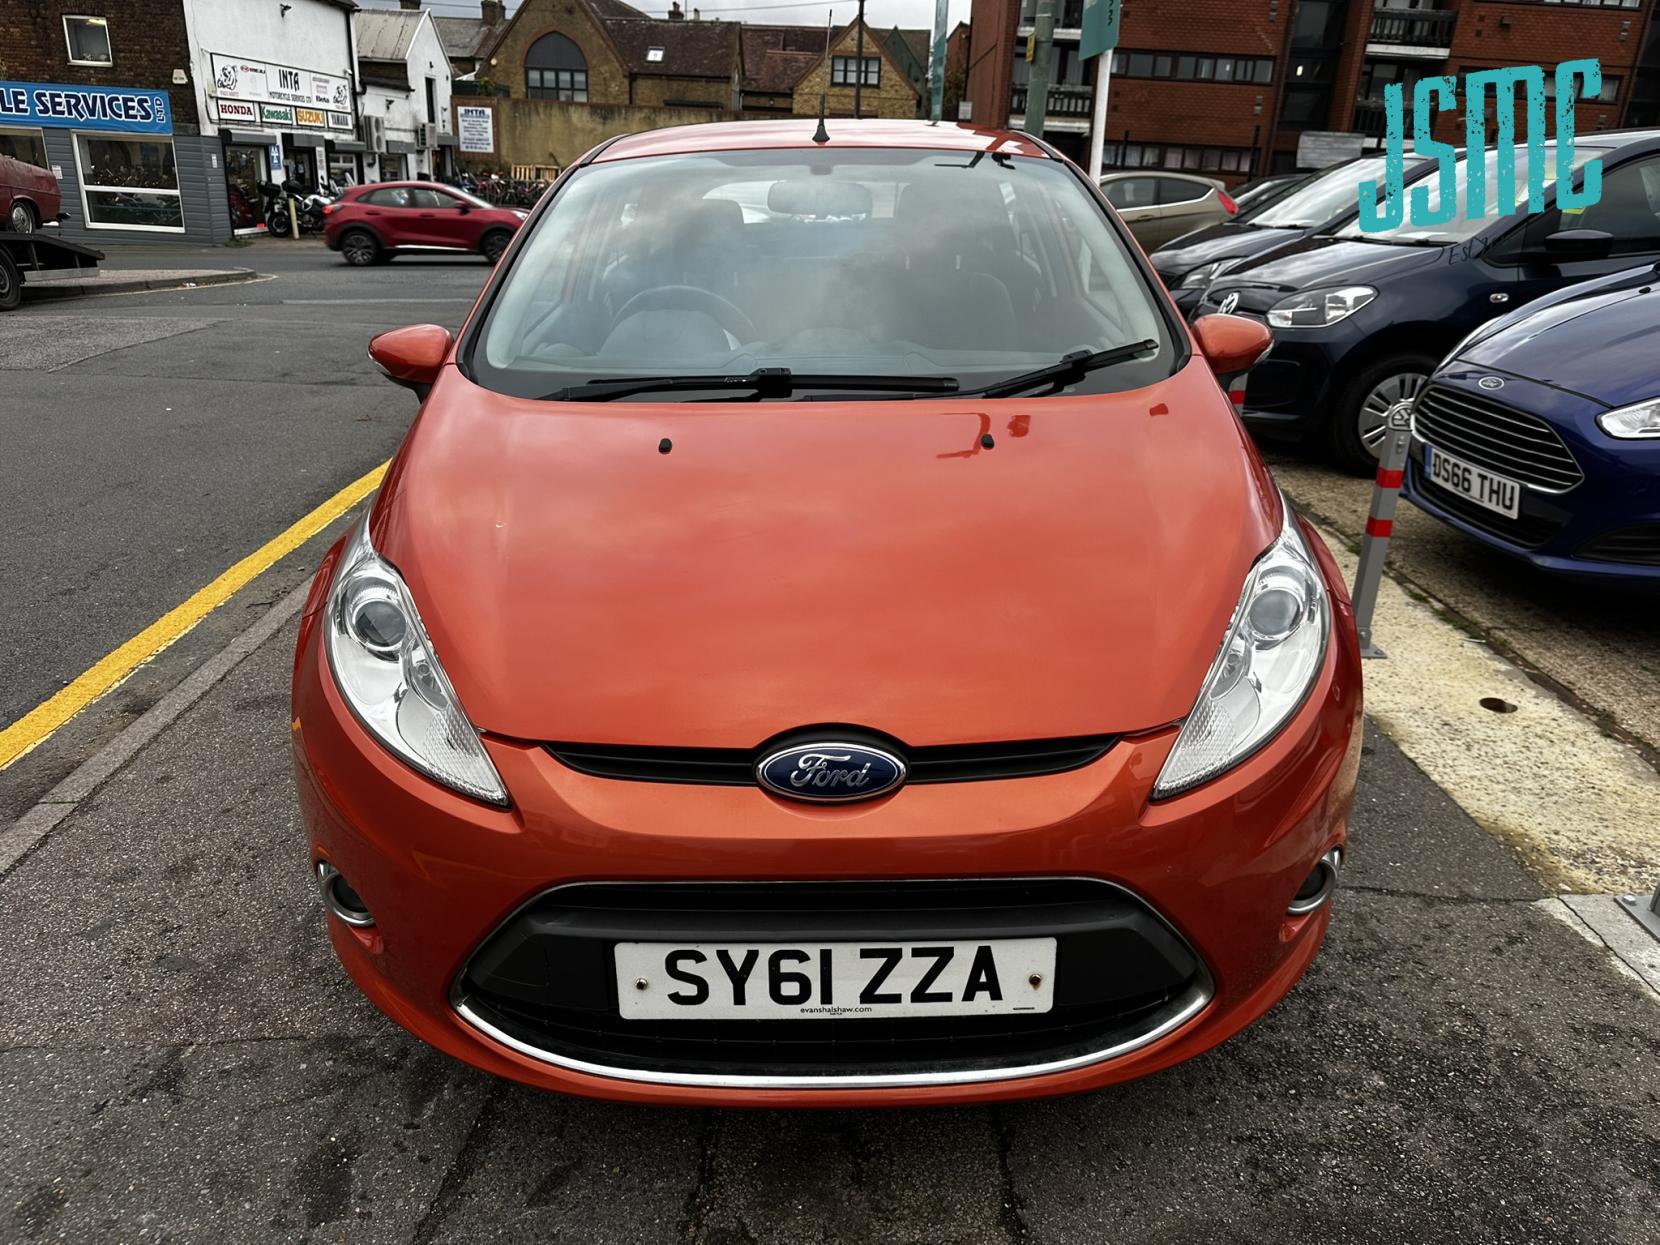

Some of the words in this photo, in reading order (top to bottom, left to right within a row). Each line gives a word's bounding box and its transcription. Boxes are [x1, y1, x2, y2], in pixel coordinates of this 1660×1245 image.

[279, 68, 300, 91] INTA
[34, 90, 153, 121] SERVICES
[154, 97, 165, 123] LTD
[220, 104, 253, 115] HONDA
[261, 106, 292, 121] Kawasaki
[297, 109, 324, 123] SUZUKI
[1433, 452, 1472, 493] DS66
[1478, 473, 1514, 511] THU
[790, 753, 871, 788] Ford
[664, 948, 833, 1006] SY61
[859, 945, 1003, 1004] ZZA
